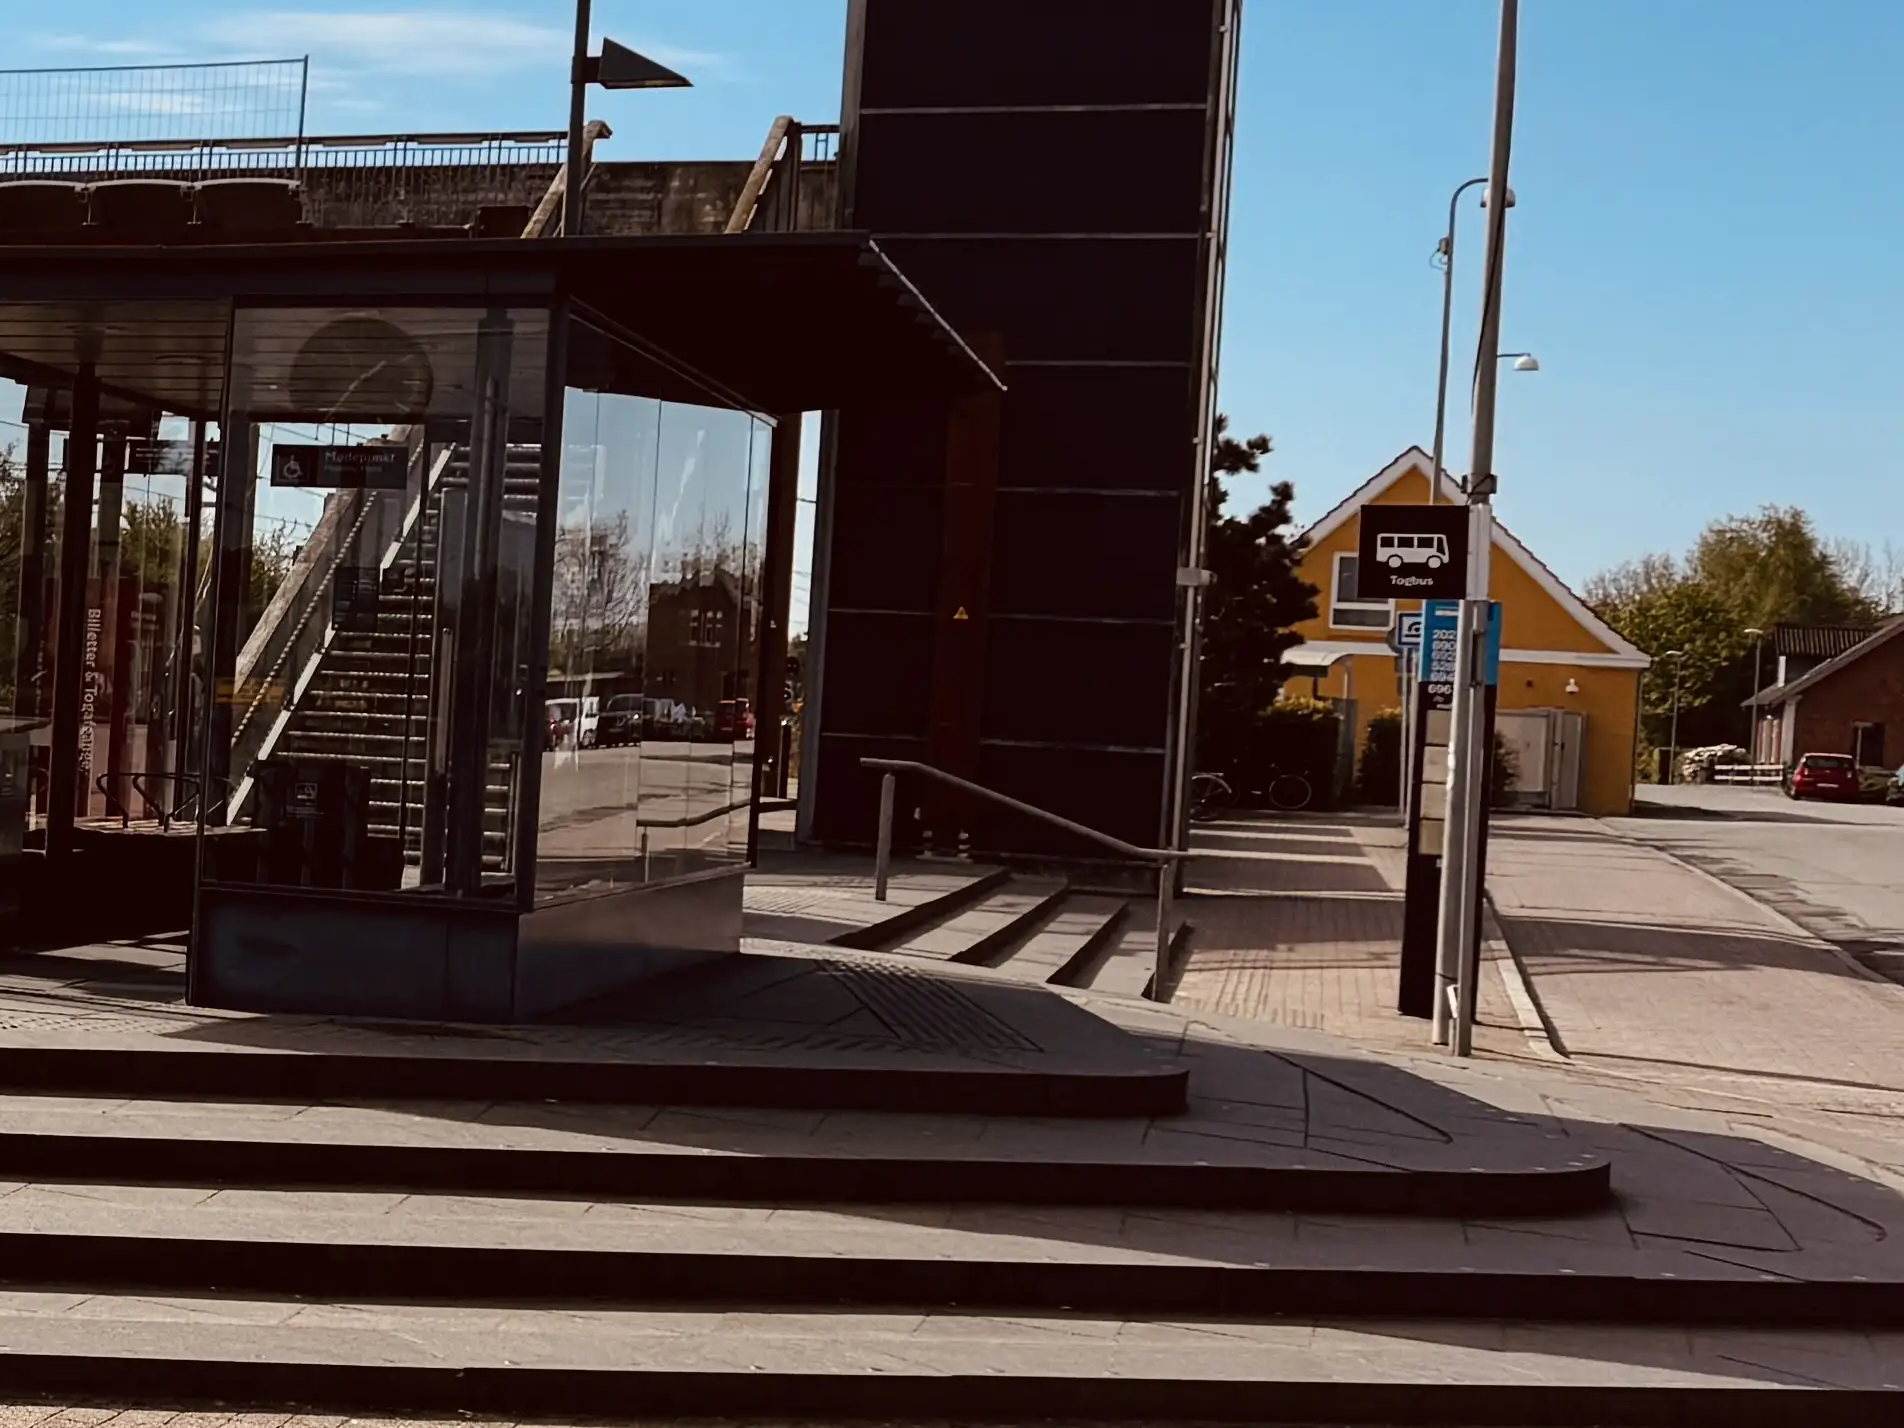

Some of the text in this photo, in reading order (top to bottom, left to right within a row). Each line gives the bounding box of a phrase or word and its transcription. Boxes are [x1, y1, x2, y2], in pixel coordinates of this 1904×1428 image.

[324, 449, 395, 465] Mødepunkt
[1390, 574, 1434, 587] Togbus
[85, 608, 102, 668] Billetter
[84, 671, 95, 683] &
